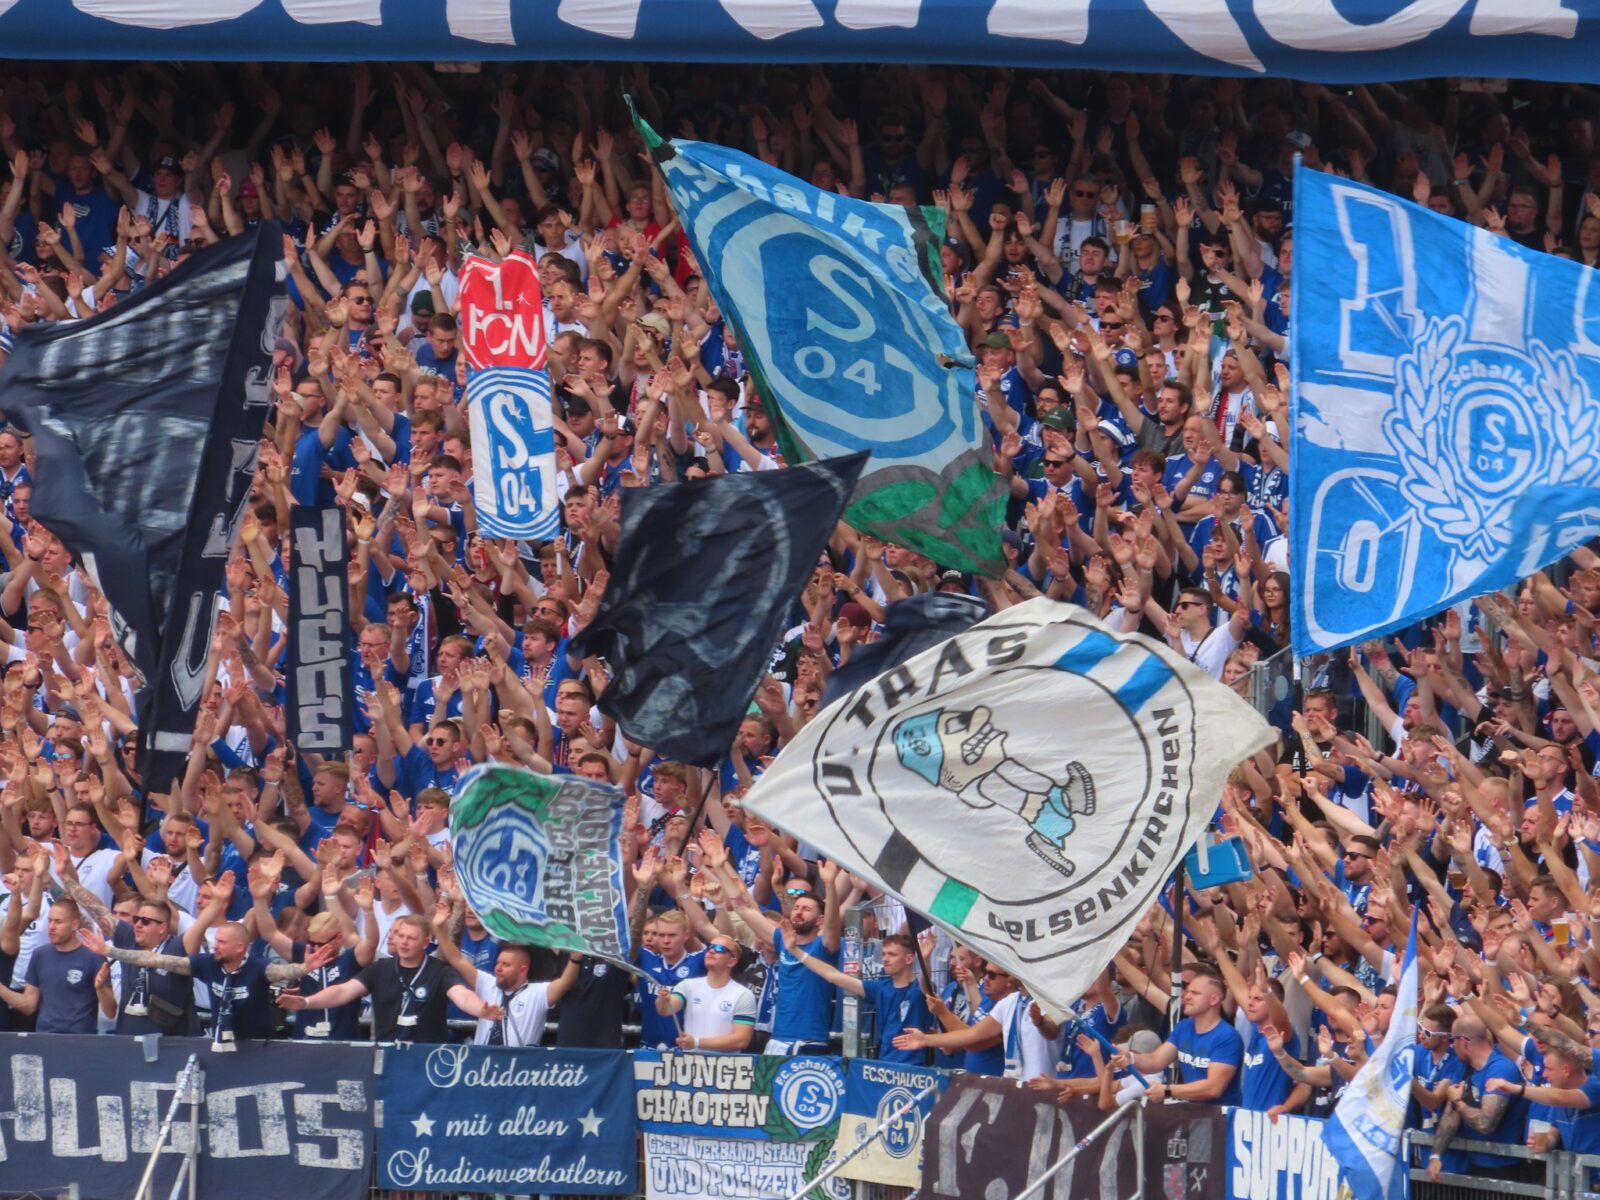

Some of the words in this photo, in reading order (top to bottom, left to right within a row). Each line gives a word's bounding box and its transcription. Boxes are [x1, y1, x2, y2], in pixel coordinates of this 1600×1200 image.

[793, 345, 883, 396] 04
[1450, 358, 1538, 399] Schalke
[1476, 456, 1505, 473] 04
[500, 470, 537, 517] 04
[821, 630, 1029, 800] UTRAS
[425, 1043, 589, 1088] Solidarität
[653, 1052, 754, 1090] JUNGE
[790, 1059, 837, 1080] Schalke
[445, 1113, 492, 1138] mit
[498, 1105, 569, 1137] allen
[636, 1088, 770, 1128] CHAOTEN
[798, 1104, 815, 1113] 04
[890, 1131, 906, 1146] 04
[387, 1147, 628, 1187] Stadionverbotlern
[651, 1157, 703, 1195] UND
